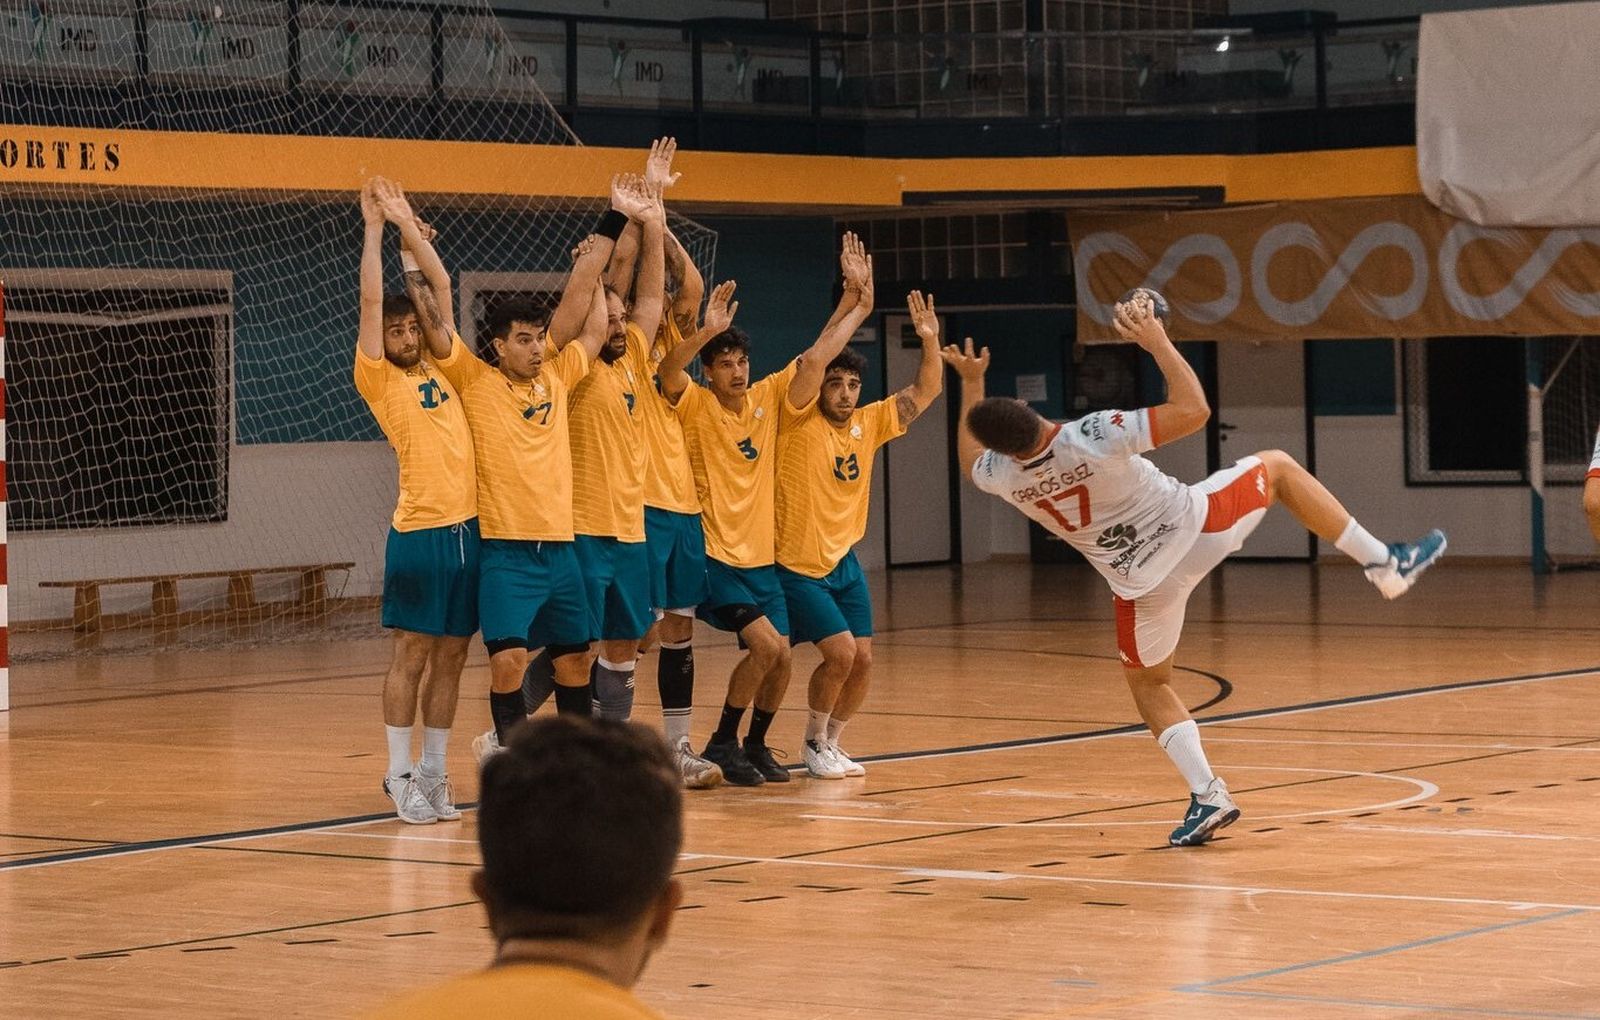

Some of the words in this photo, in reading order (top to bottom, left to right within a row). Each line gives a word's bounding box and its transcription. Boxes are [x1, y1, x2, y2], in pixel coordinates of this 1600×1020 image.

[221, 37, 256, 60] IMD
[508, 56, 538, 77] IMD
[635, 61, 664, 82] IMD
[0, 139, 120, 172] ORTES
[736, 436, 758, 460] 3
[1012, 477, 1061, 503] CARLOS
[1034, 484, 1092, 533] 17
